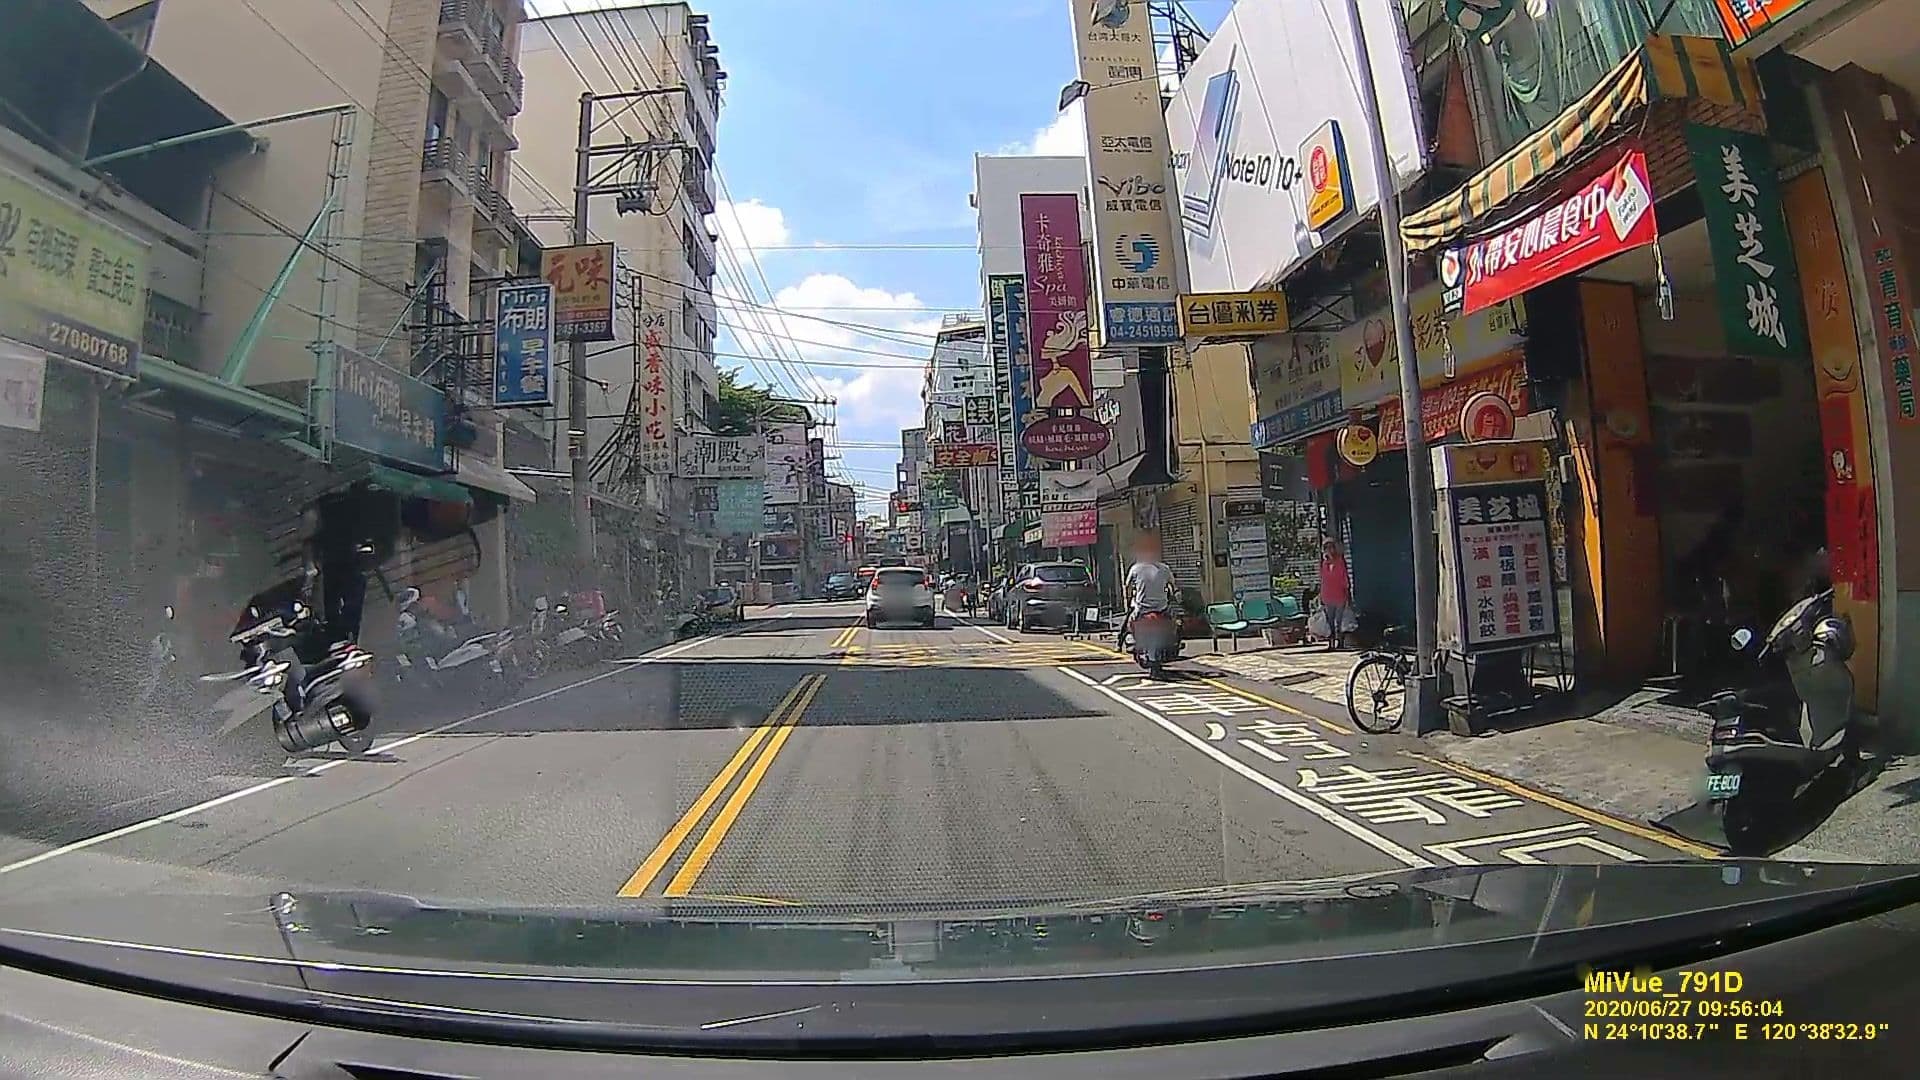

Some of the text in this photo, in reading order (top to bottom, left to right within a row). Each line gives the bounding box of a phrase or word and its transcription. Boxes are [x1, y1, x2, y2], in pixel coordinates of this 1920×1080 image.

[1101, 137, 1153, 149] 亞太電信
[1106, 200, 1162, 212] 威寶電信
[1720, 144, 1788, 348] 美芝城
[1112, 277, 1169, 290] 中華電信
[500, 306, 547, 335] 布朗
[1110, 325, 1179, 338] 04-2451959
